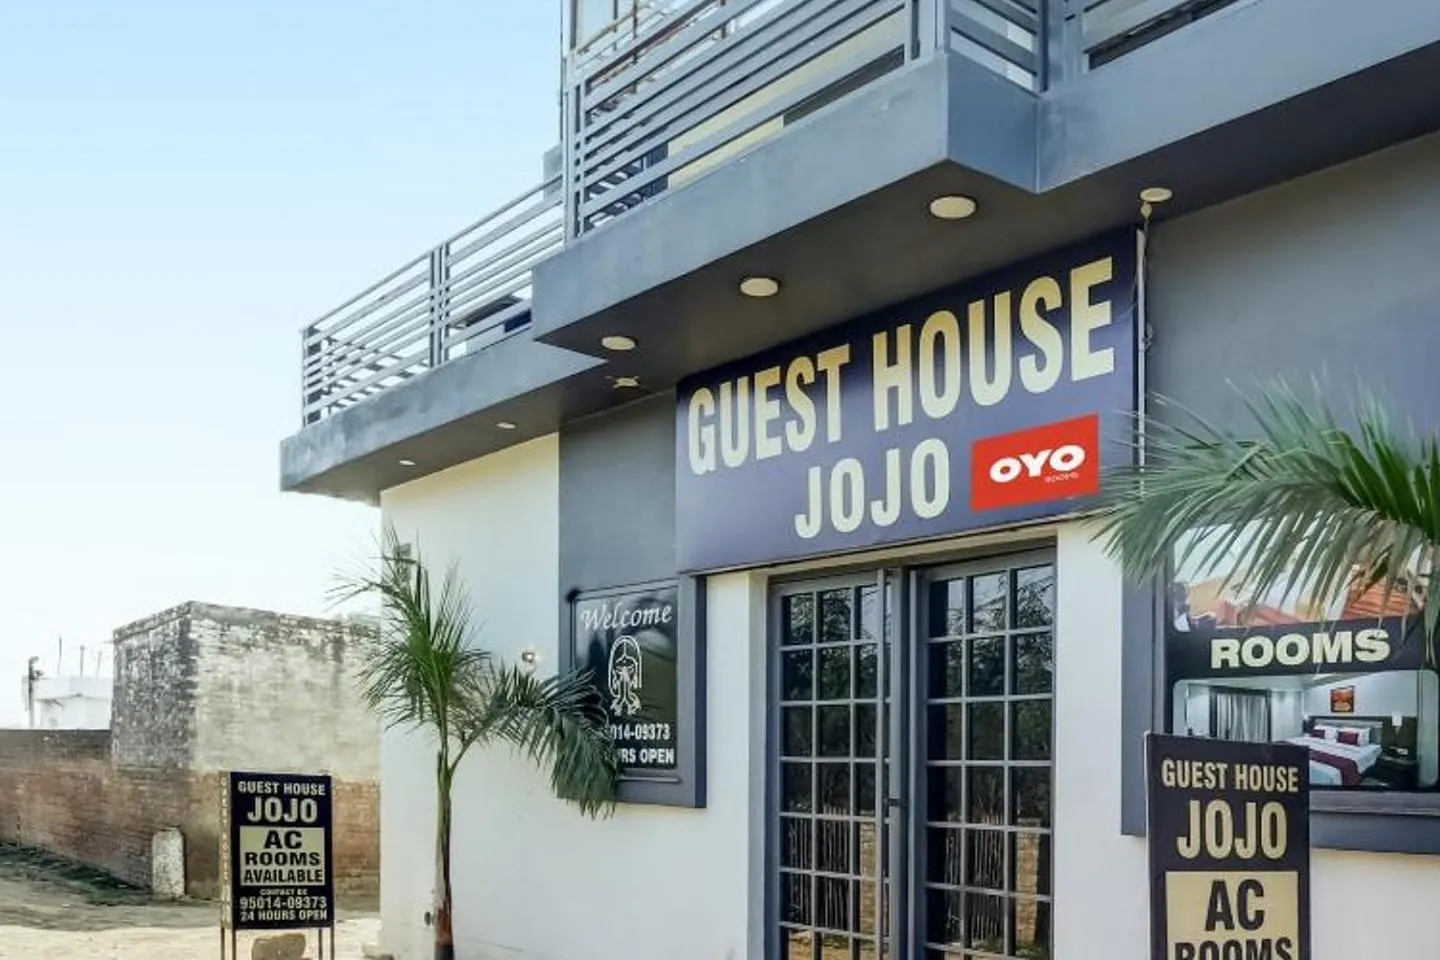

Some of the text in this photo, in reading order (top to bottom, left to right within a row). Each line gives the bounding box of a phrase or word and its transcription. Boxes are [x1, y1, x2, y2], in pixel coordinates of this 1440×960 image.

[687, 256, 1116, 476] GUEST HOUSE
[989, 444, 1086, 483] OYO
[794, 438, 951, 539] JOJO
[580, 602, 672, 632] Welcome
[1211, 629, 1391, 669] ROOMS
[609, 722, 671, 740] 014-09373
[640, 747, 675, 764] OPEN
[238, 781, 326, 796] GUEST HOUSE
[1161, 758, 1299, 792] GUEST HOUSE
[247, 796, 318, 823] JOJO
[263, 829, 303, 849] AC
[1176, 799, 1288, 859] JOJO
[245, 852, 321, 866] ROOMS
[243, 869, 323, 884] AVAILABLE
[240, 896, 327, 909] 95014-09373
[240, 909, 327, 921] 24 HOURS OPEN
[1205, 878, 1265, 932] AC
